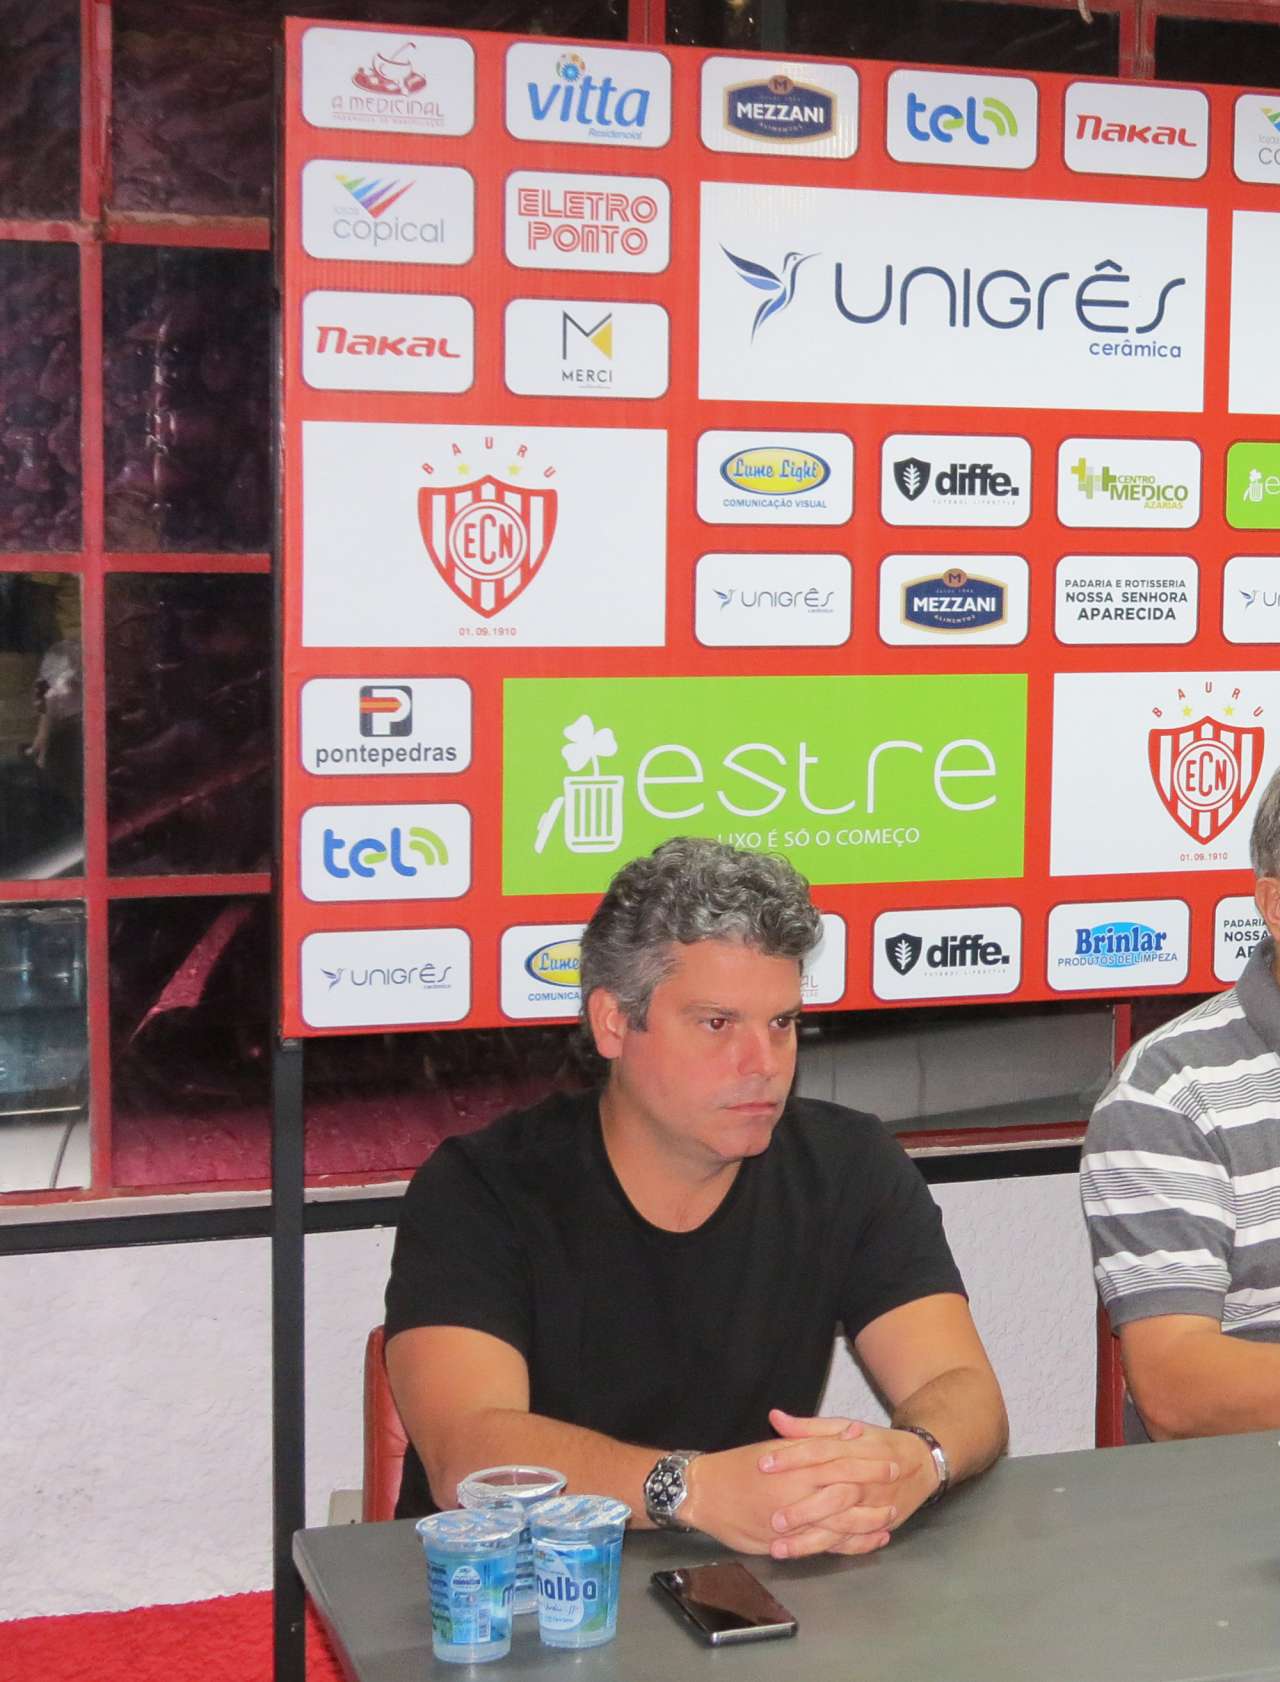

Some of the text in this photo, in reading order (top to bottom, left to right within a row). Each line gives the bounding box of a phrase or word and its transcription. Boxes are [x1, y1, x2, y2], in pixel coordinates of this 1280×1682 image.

[527, 71, 651, 128] vitta
[736, 102, 825, 124] MEZZANI
[907, 92, 990, 145] tel
[517, 187, 658, 223] ELETRO
[333, 217, 446, 248] copical
[528, 221, 648, 256] PONTO
[1090, 340, 1182, 359] cerâmica
[562, 369, 613, 384] MERCI
[421, 436, 556, 479] BAURU
[733, 458, 819, 482] Lume Light
[935, 462, 1019, 498] diffe.
[1117, 474, 1156, 485] CENTRO
[723, 497, 828, 510] COMUNICAÇÃO VISUAL
[1110, 484, 1189, 502] MEDICO
[1143, 501, 1184, 510] AZARIAS
[463, 514, 514, 564] ECN
[1065, 579, 1186, 588] PADARIA E ROTISSERIA
[913, 596, 996, 613] MEZZANI
[1066, 591, 1188, 603] NOSSA SENHORA
[1077, 607, 1176, 621] APARECIDA
[1152, 681, 1264, 718] BAURU
[316, 743, 457, 767] pontepedras
[637, 739, 996, 819] estre
[1185, 752, 1227, 797] ECN
[769, 828, 779, 848] É
[785, 829, 811, 849] SÓ
[815, 831, 830, 848] O
[836, 827, 919, 847] COMEÇO
[324, 827, 416, 878] tel
[1074, 927, 1167, 955] Brinlar
[1224, 930, 1269, 942] NOSSA
[539, 952, 582, 971] Lume
[927, 935, 1010, 969] diffe.
[1057, 952, 1178, 967] PRODUTOS DE LIMPEZA
